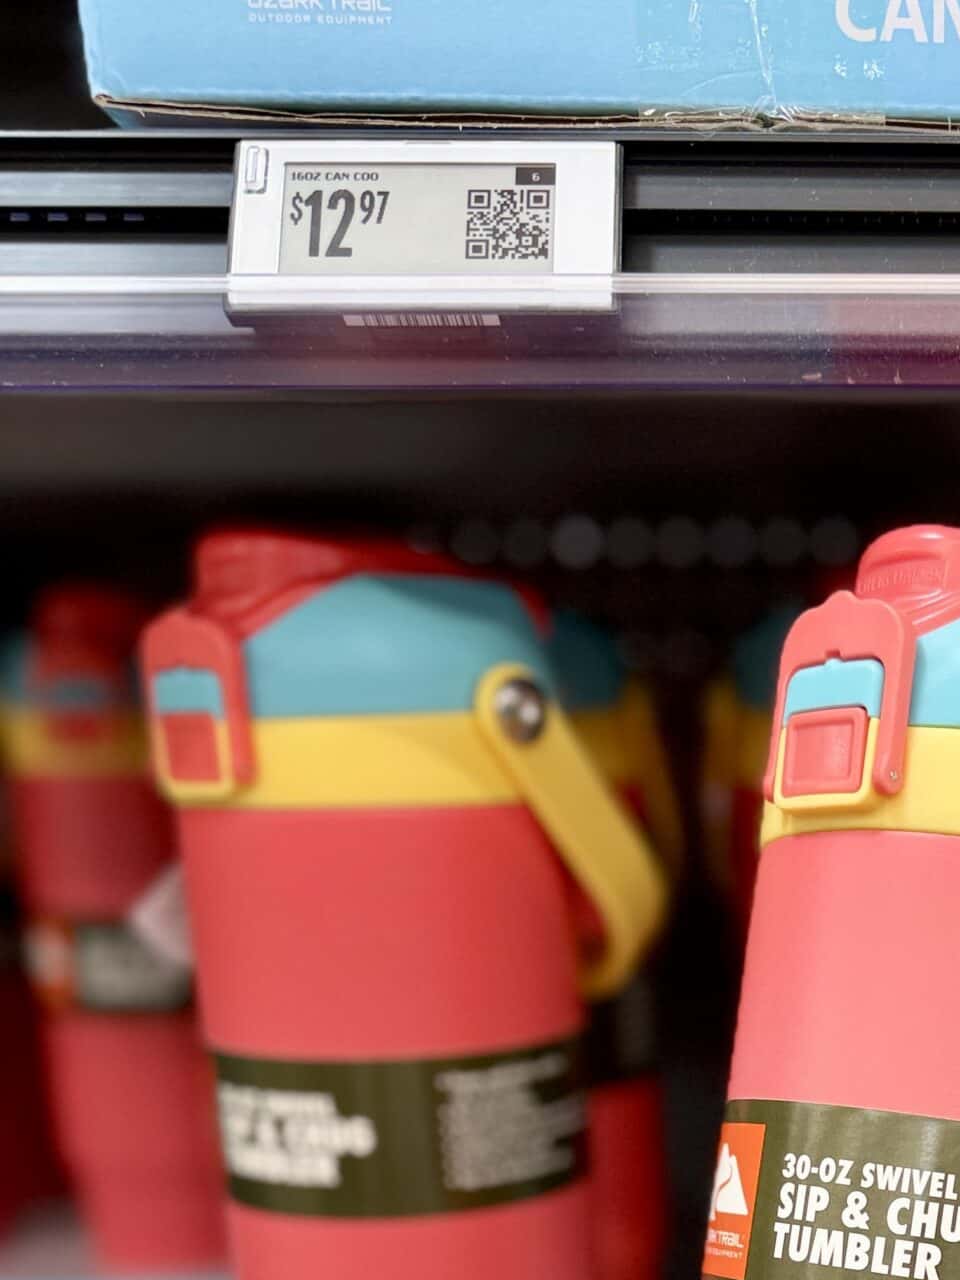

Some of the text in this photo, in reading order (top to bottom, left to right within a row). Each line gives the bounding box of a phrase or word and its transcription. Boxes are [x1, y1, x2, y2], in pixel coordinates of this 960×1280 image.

[248, 12, 393, 25] OUTDOOR EQUIPMENT
[325, 171, 350, 181] CAN
[353, 171, 379, 181] COO
[531, 171, 541, 182] 6
[781, 1151, 958, 1200] 30-OZ SWIVEL
[776, 1182, 830, 1225] SIP
[841, 1191, 871, 1230] &
